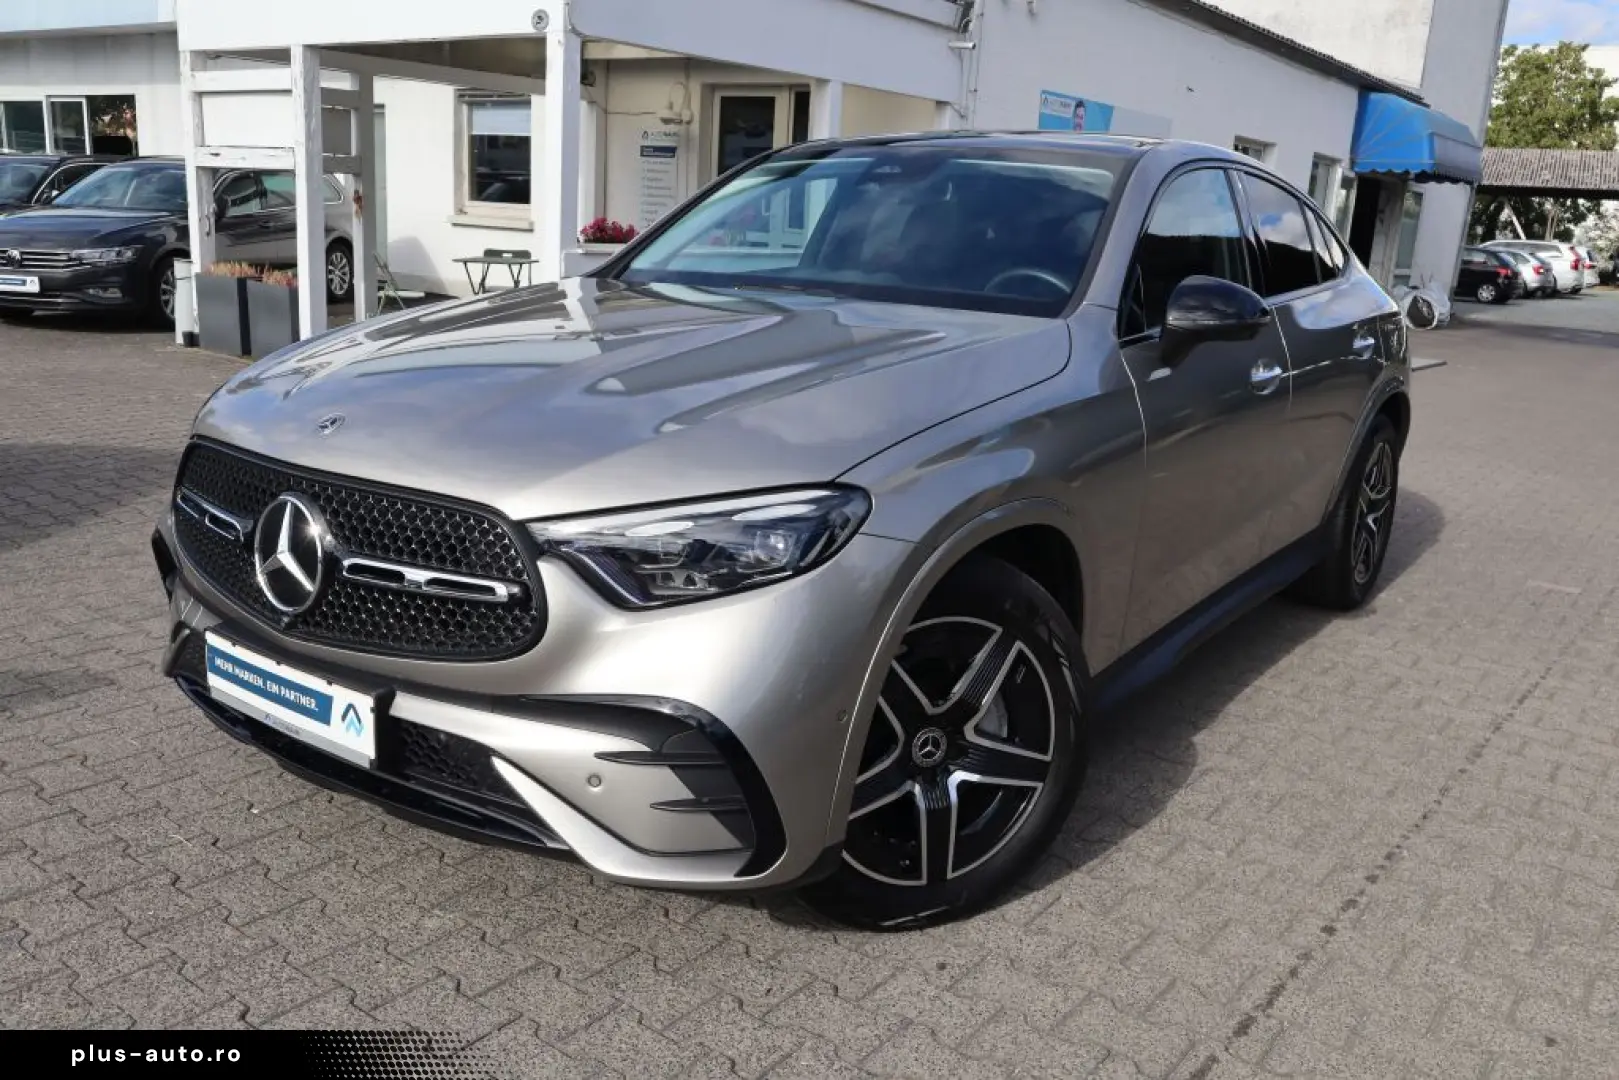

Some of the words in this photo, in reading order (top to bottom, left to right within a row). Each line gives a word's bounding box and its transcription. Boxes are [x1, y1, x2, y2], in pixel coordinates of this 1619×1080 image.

[214, 656, 233, 673] MEHR
[266, 680, 279, 695] EIN
[281, 687, 318, 710] PARTNER.
